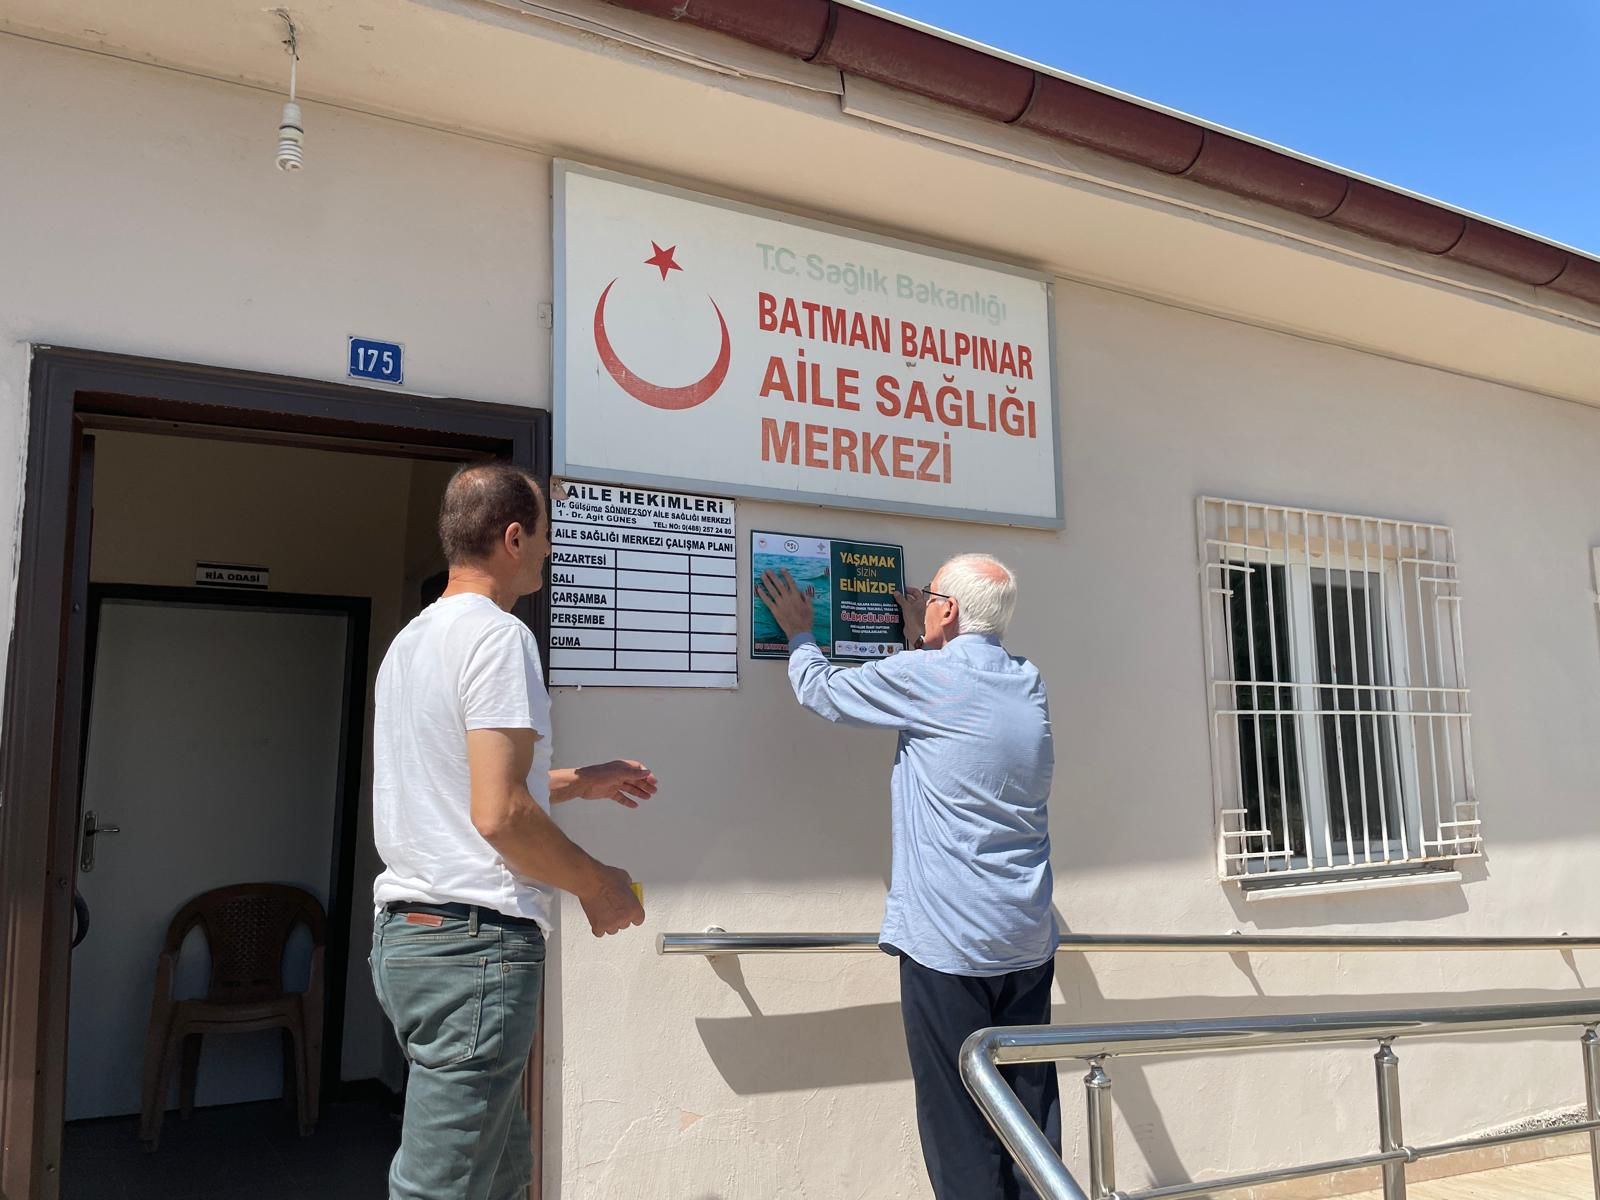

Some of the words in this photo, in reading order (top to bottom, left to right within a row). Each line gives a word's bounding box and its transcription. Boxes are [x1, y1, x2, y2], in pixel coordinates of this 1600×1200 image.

[756, 242, 799, 277] T.C.
[806, 254, 888, 296] Sağlık
[897, 276, 1007, 326] Bakanlığı
[758, 292, 891, 353] BATMAN
[902, 321, 1033, 380] BALPINAR
[358, 347, 394, 374] 175
[759, 348, 860, 411] AİLE
[876, 373, 1037, 439] SAĞLIĞI
[761, 418, 952, 484] MERKEZİ
[556, 500, 566, 509] Dr.
[653, 510, 670, 519] AİLE
[671, 511, 700, 522] SAĞLIĞI
[701, 516, 732, 525] MERKEZİ
[571, 511, 584, 520] Dr.
[580, 530, 619, 543] SAĞLIĞI
[665, 538, 705, 551] ÇALIŞMA
[707, 541, 733, 553] PLANI
[552, 552, 607, 566] PAZARTESİ
[840, 552, 896, 568] YAŞAMAK
[552, 573, 575, 584] SALI
[856, 567, 877, 578] SİZİN
[840, 577, 896, 594] ELİNİZDE
[552, 592, 607, 605] ÇARŞAMBA
[551, 613, 605, 626] PERŞEMBE
[551, 636, 581, 647] CUMA
